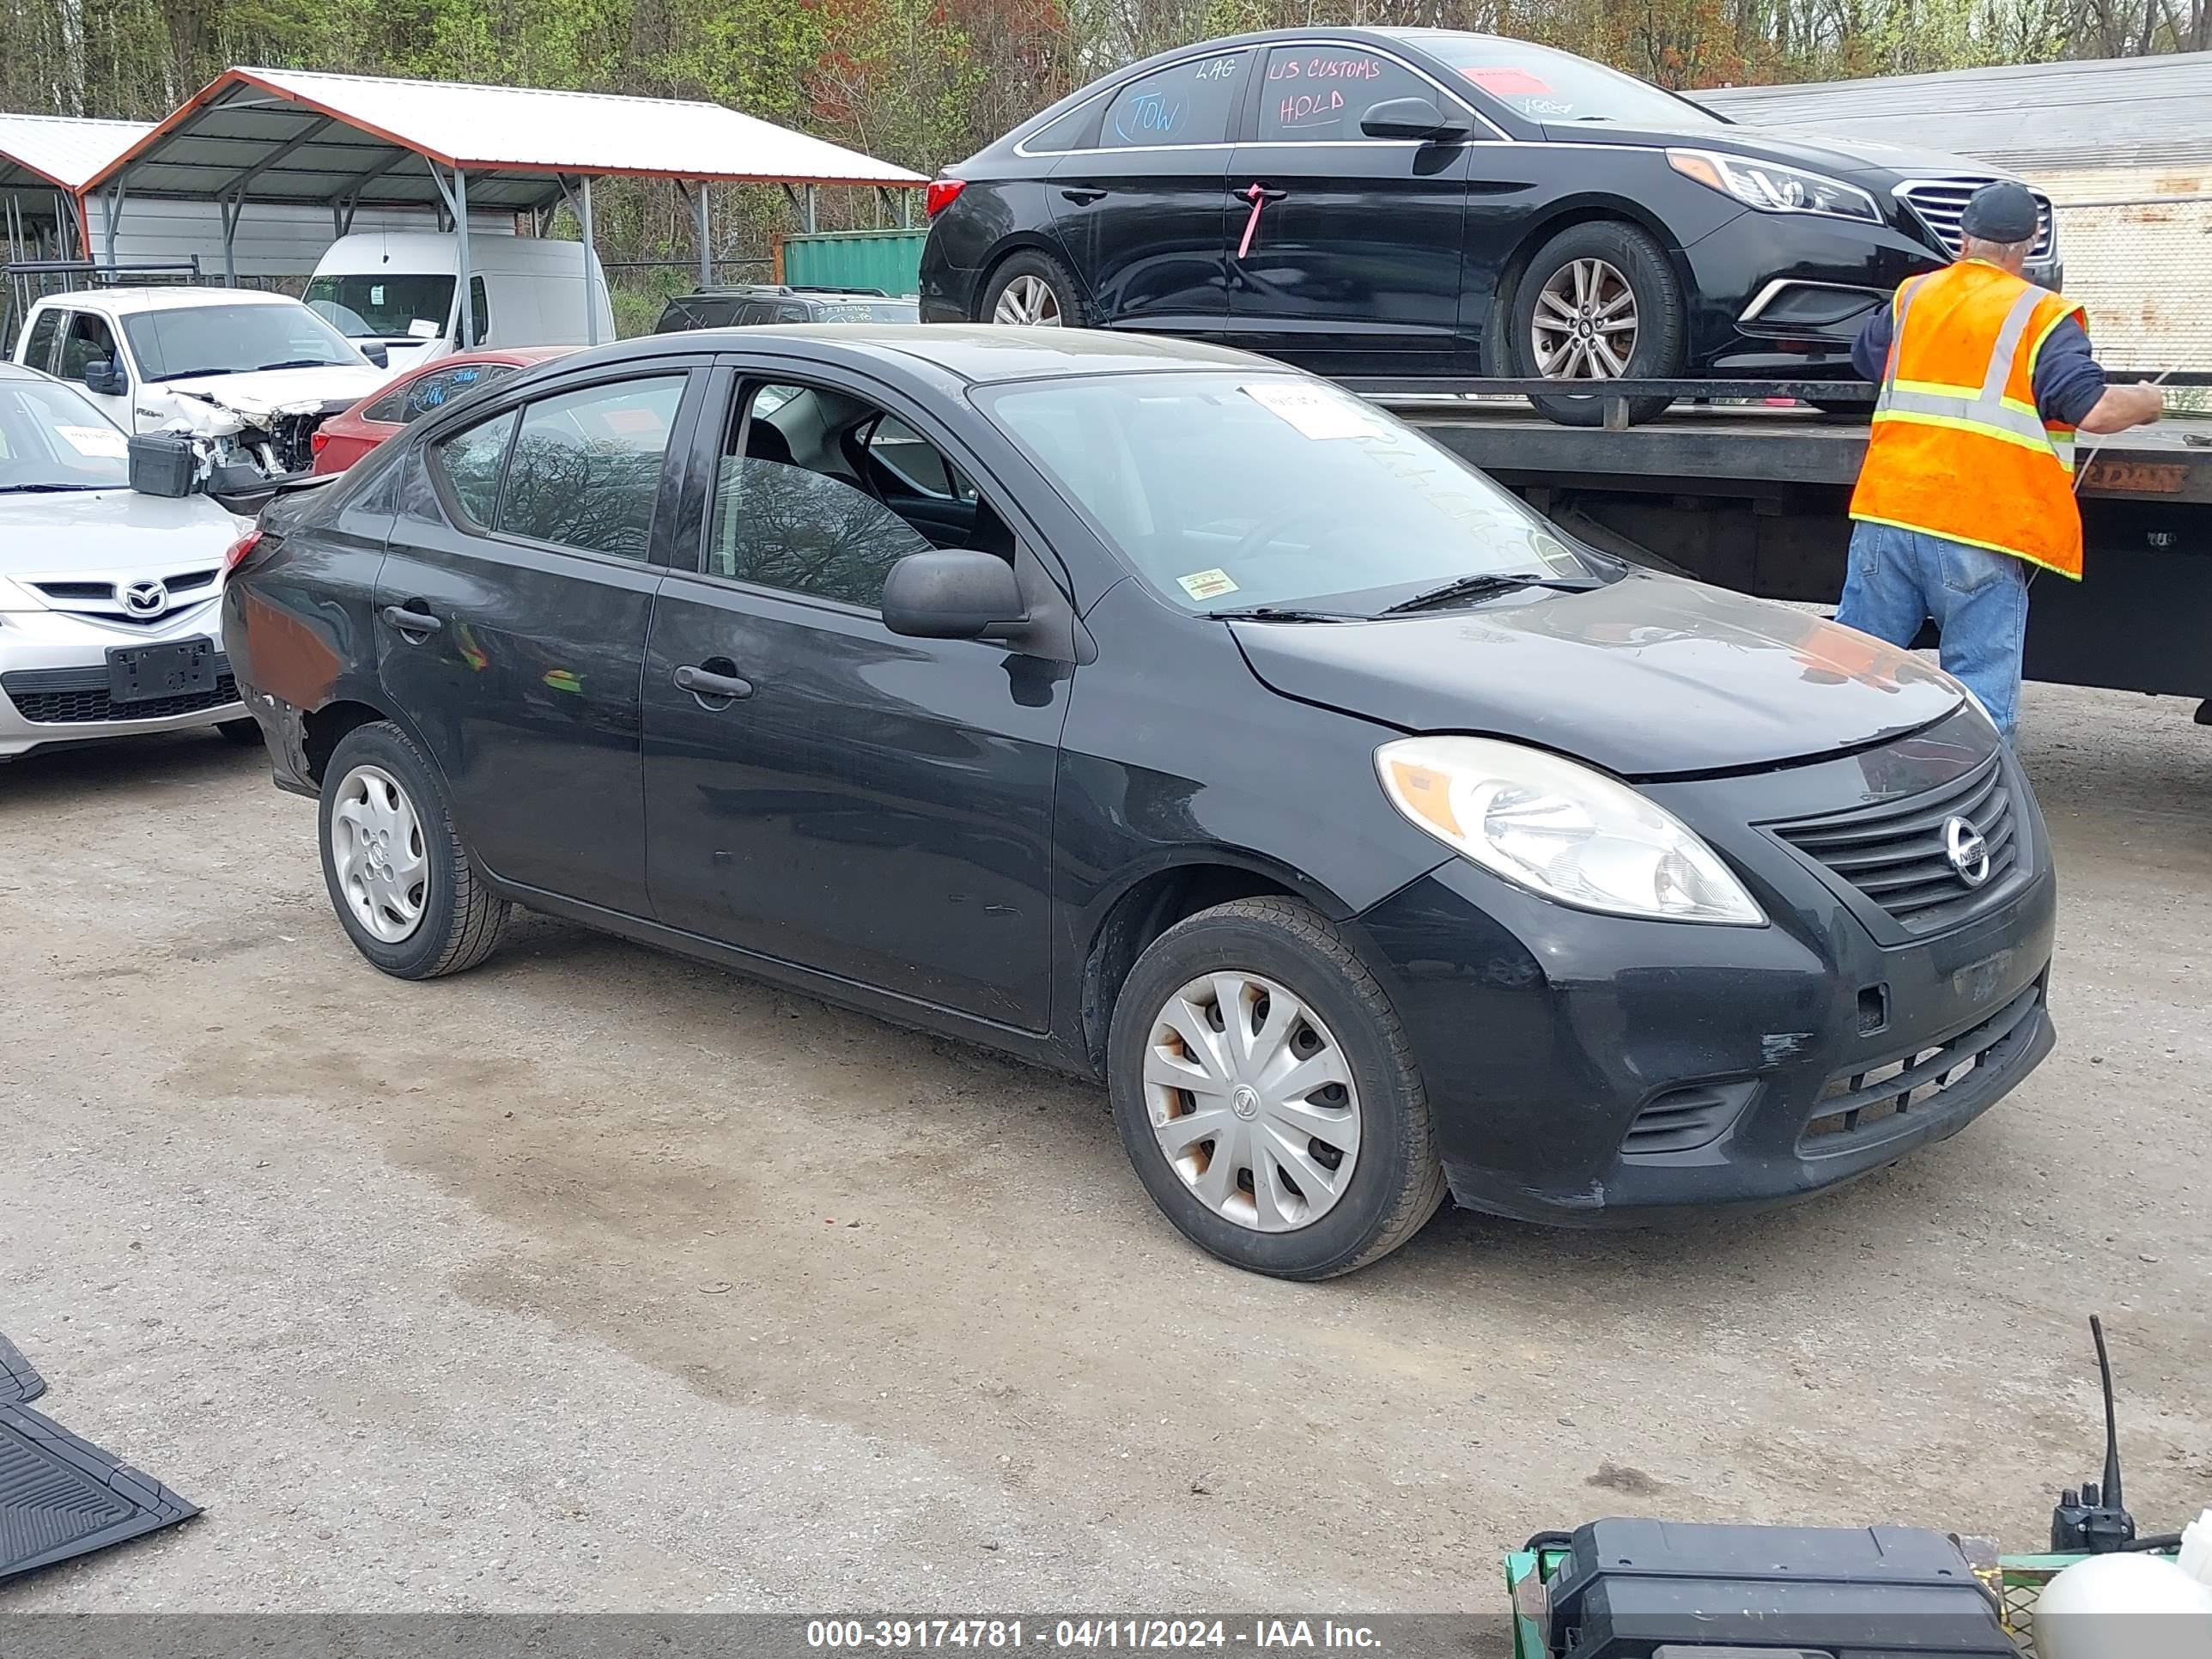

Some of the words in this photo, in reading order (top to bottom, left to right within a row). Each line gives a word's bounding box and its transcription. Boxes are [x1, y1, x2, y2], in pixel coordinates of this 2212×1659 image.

[1195, 58, 1237, 80] LAG
[1269, 61, 1300, 80] US
[1308, 58, 1381, 80] CUSTOMS
[1129, 93, 1181, 134] TOW
[1280, 90, 1345, 122] HOLD
